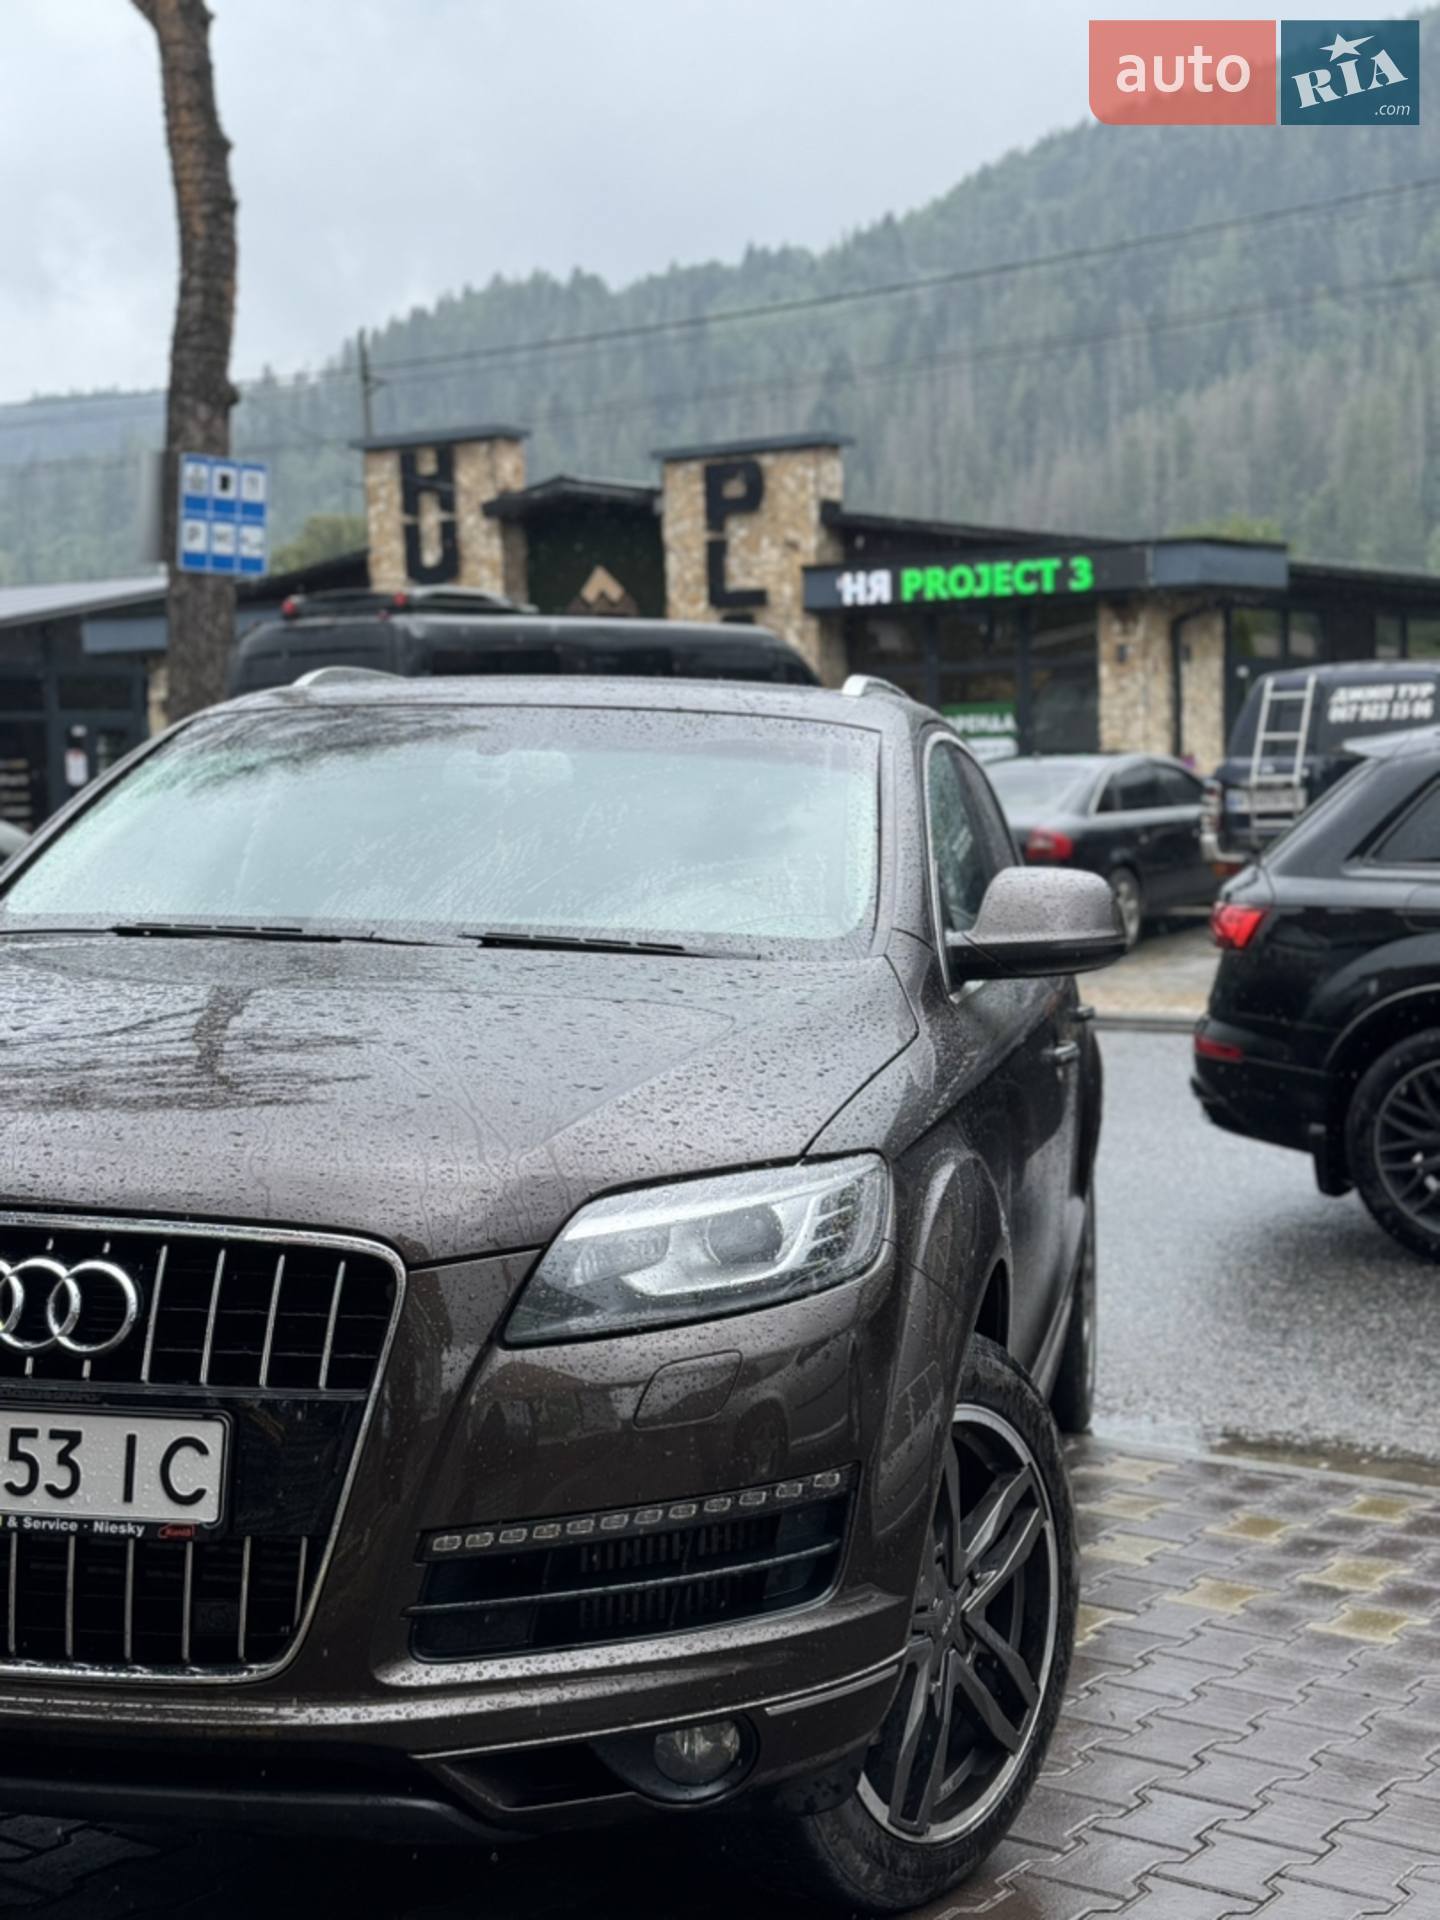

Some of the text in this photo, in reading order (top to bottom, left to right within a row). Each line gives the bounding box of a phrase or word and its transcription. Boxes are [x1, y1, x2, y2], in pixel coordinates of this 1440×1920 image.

[901, 557, 1061, 602] PROJECT
[1068, 556, 1094, 592] 3
[4, 1427, 209, 1506] 53 IC
[7, 1516, 18, 1528] &
[23, 1516, 78, 1532] Service
[93, 1521, 145, 1537] Niesky
